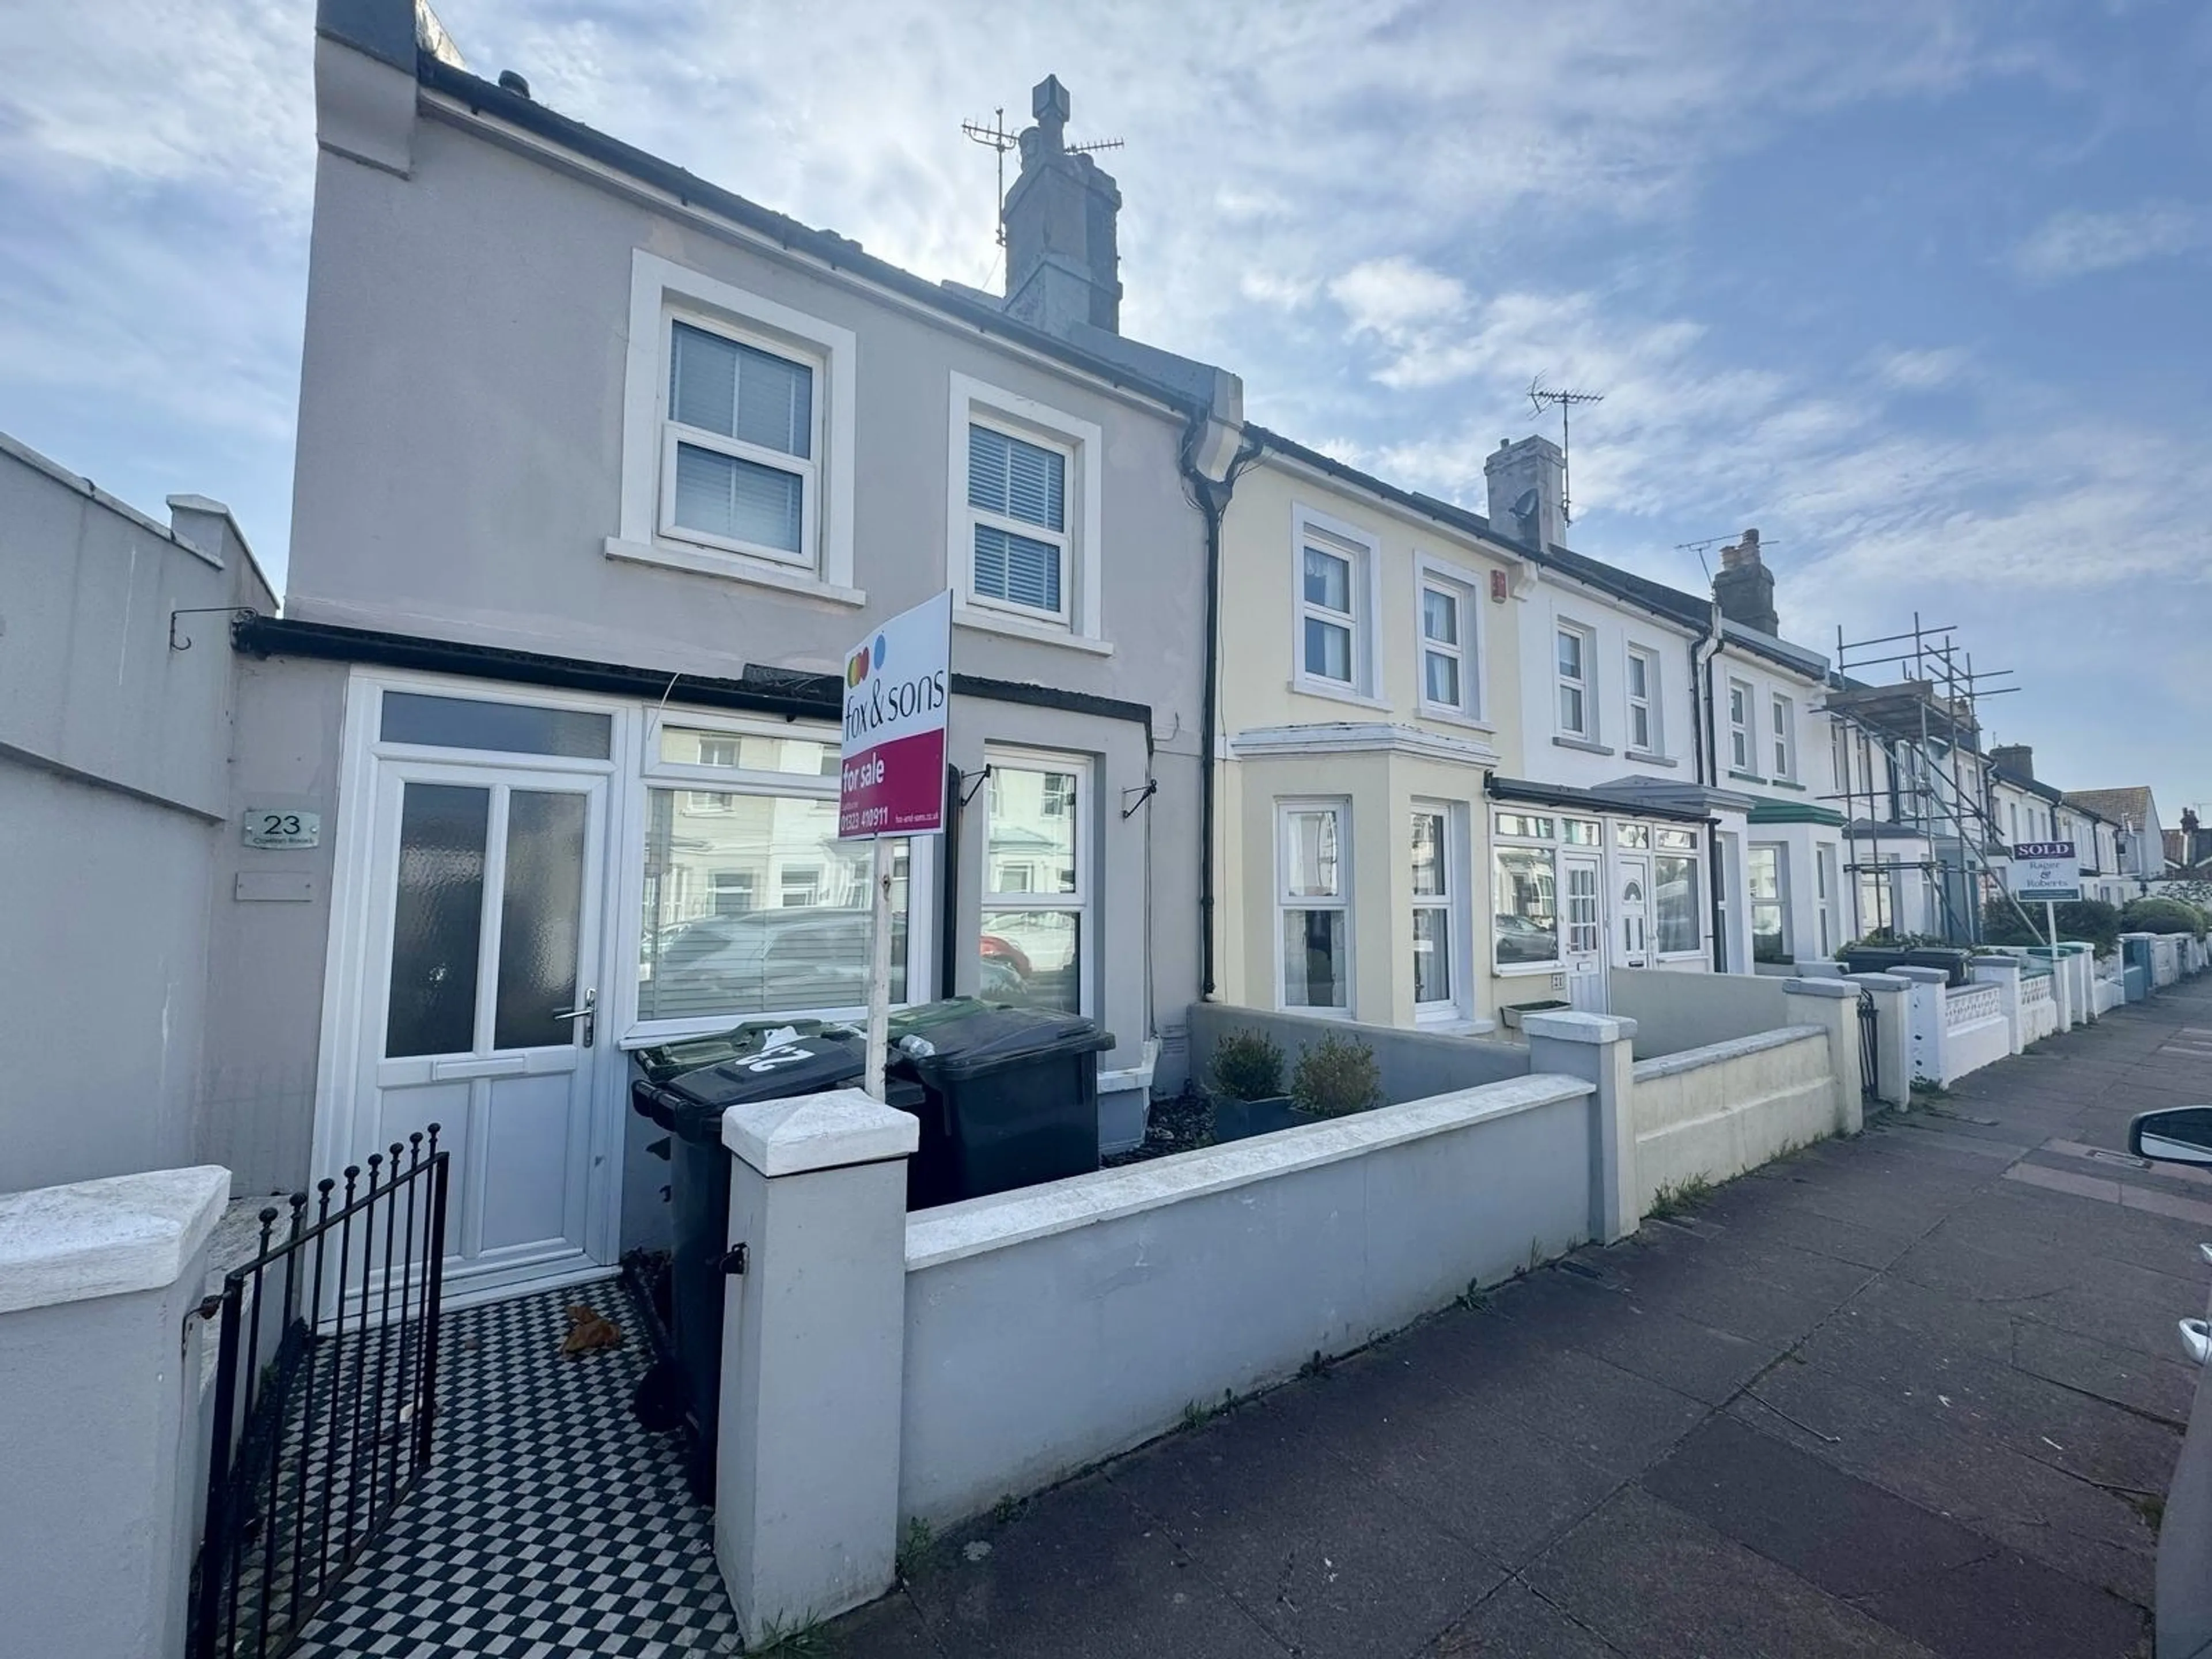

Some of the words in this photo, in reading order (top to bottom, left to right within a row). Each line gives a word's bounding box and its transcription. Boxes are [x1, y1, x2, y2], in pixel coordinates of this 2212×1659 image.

[846, 695, 868, 741] fox
[870, 678, 884, 728] &
[887, 670, 944, 722] sons
[843, 763, 859, 793] for
[861, 752, 884, 788] sale
[263, 815, 300, 835] 23
[2018, 843, 2069, 856] SOLD
[2027, 879, 2069, 888] Roberts
